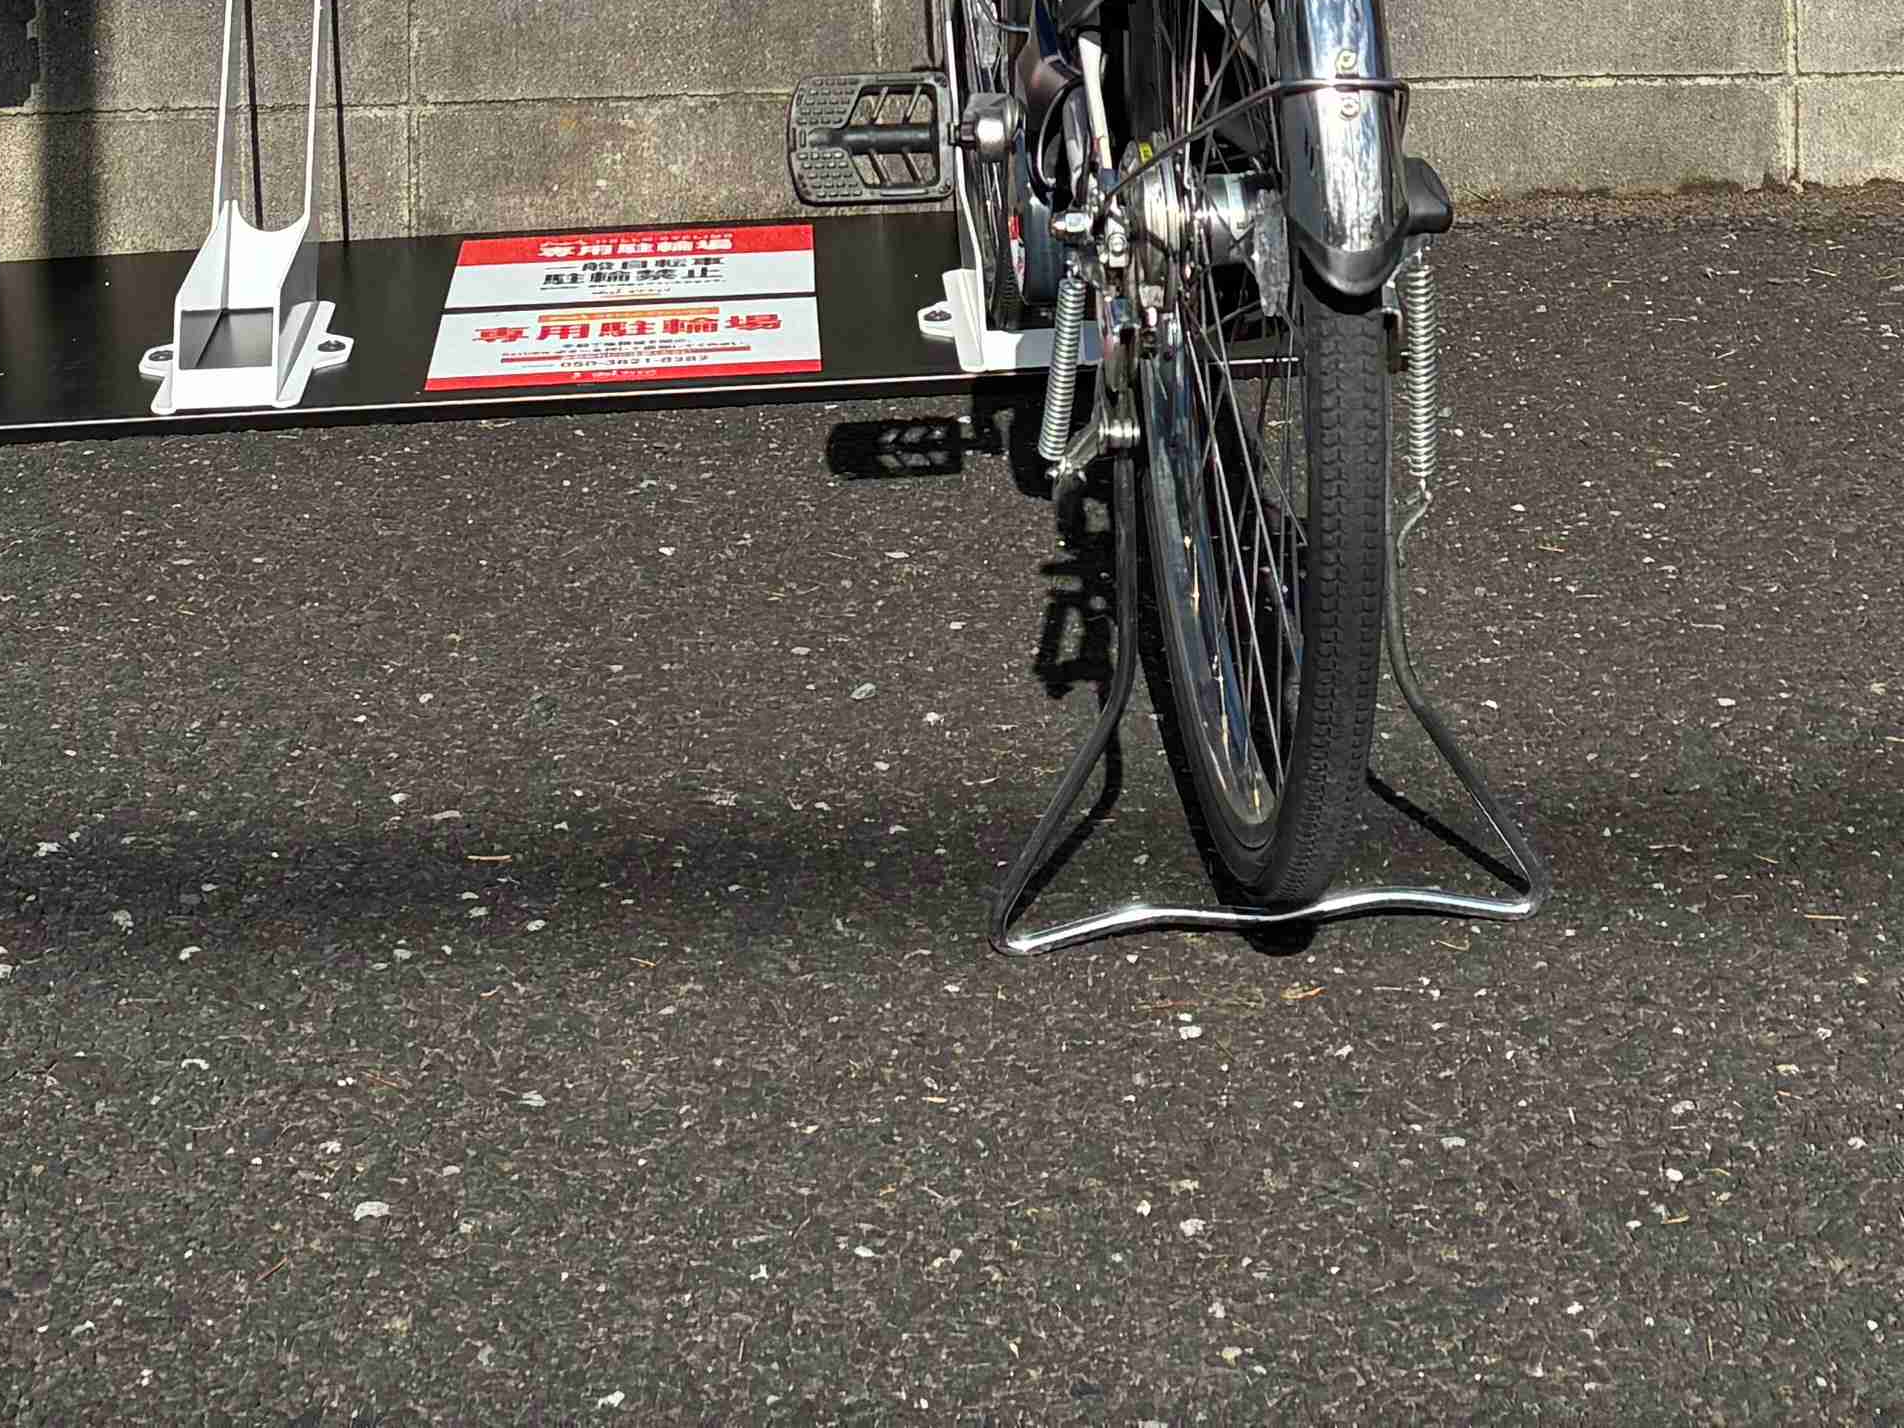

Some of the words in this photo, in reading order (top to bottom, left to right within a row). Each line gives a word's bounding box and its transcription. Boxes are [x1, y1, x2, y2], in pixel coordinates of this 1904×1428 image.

[538, 239, 733, 258] 専用駐輪場
[545, 257, 725, 272] 一般自転車
[543, 267, 724, 285] 駐輪禁止
[472, 314, 783, 343] 専用駐輪場
